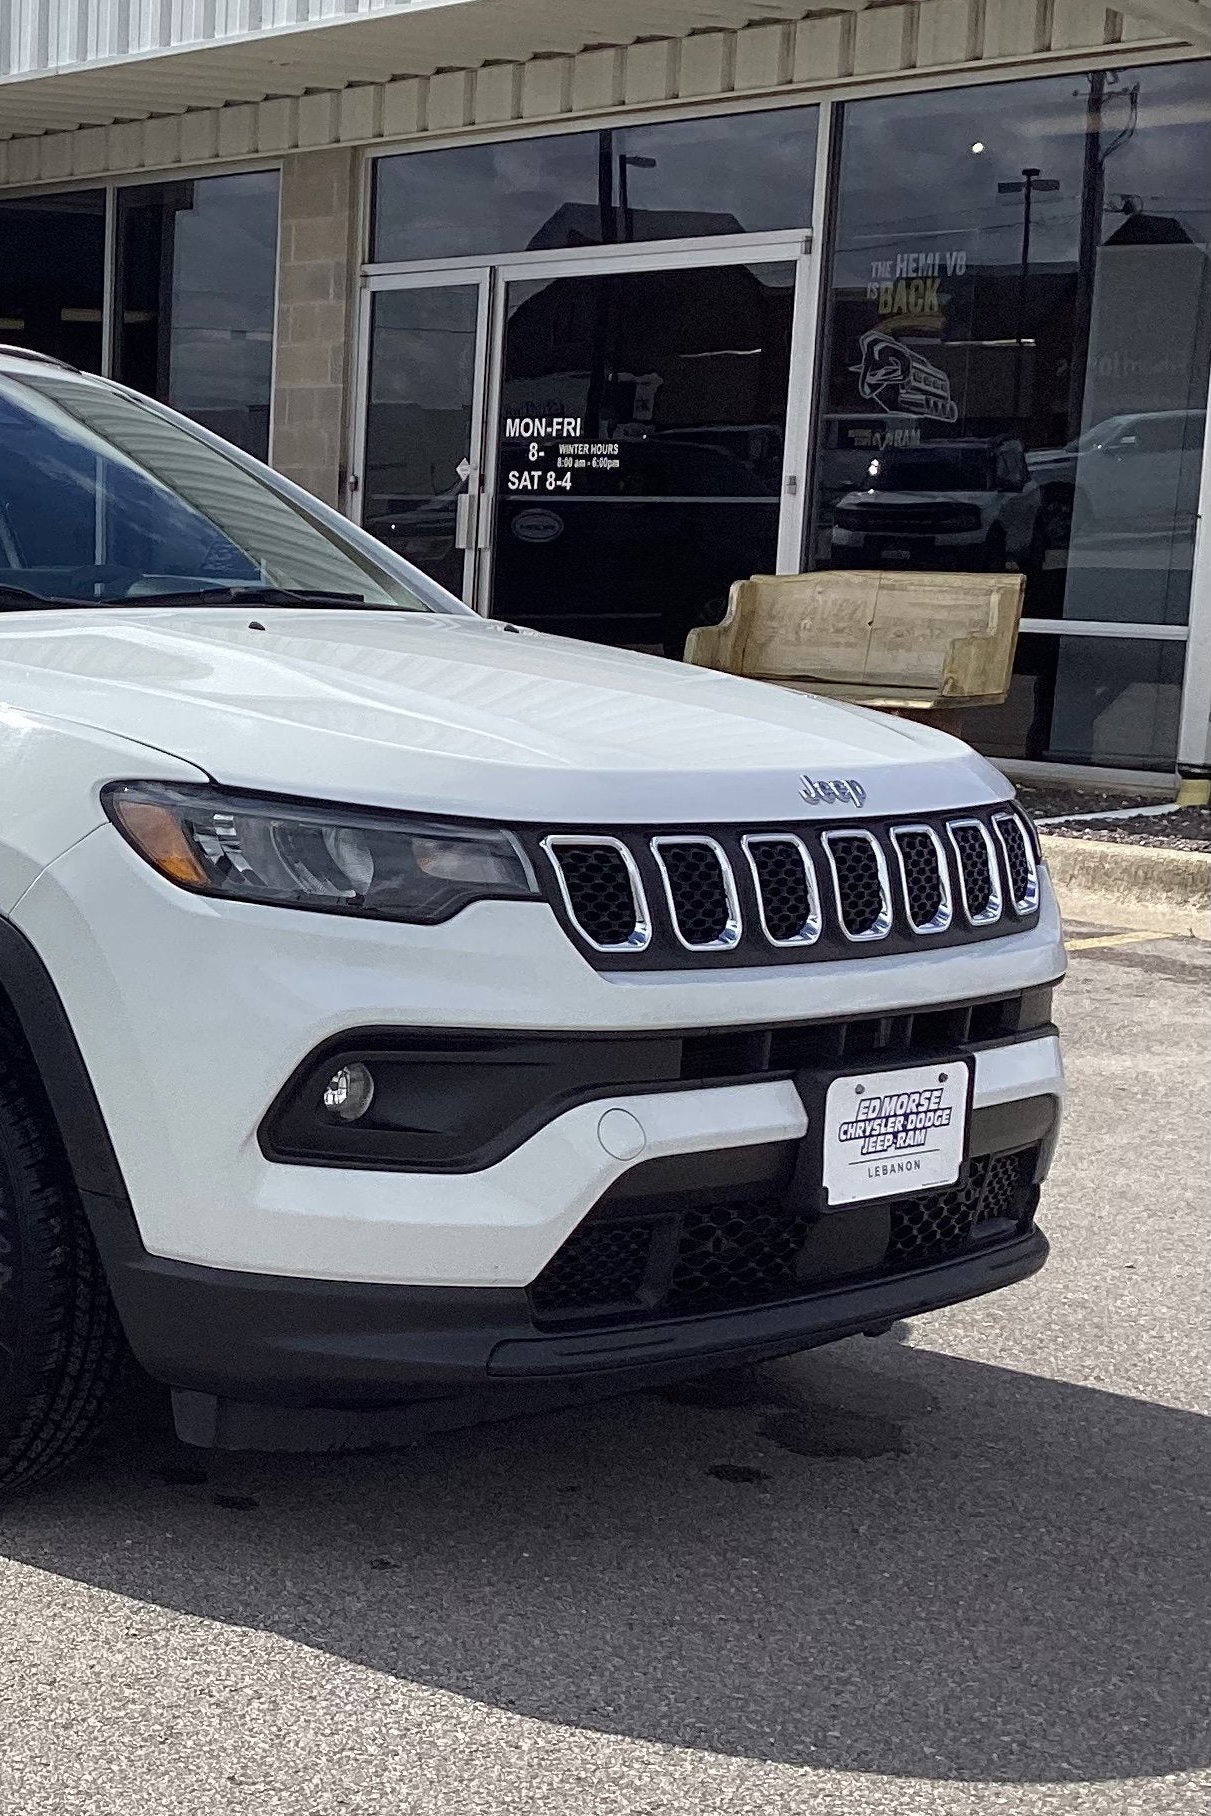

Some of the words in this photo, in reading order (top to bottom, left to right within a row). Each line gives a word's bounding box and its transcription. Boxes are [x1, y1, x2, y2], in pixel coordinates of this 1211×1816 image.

[871, 261, 894, 278] THE
[895, 251, 940, 277] HEMI
[945, 250, 967, 276] V8
[866, 282, 879, 299] IS
[878, 278, 942, 314] BACK
[505, 418, 581, 437] MON-FRI
[894, 429, 921, 447] RAM
[559, 443, 589, 455] WINTER
[590, 443, 619, 455] HOURS
[557, 457, 573, 468] 8:00
[574, 459, 586, 468] am
[508, 470, 542, 490] SAT
[546, 471, 572, 490] 8-4
[798, 774, 867, 808] Jeep
[857, 1097, 882, 1121] ED
[881, 1088, 944, 1117] MORSE
[867, 1160, 922, 1178] LEBANON
